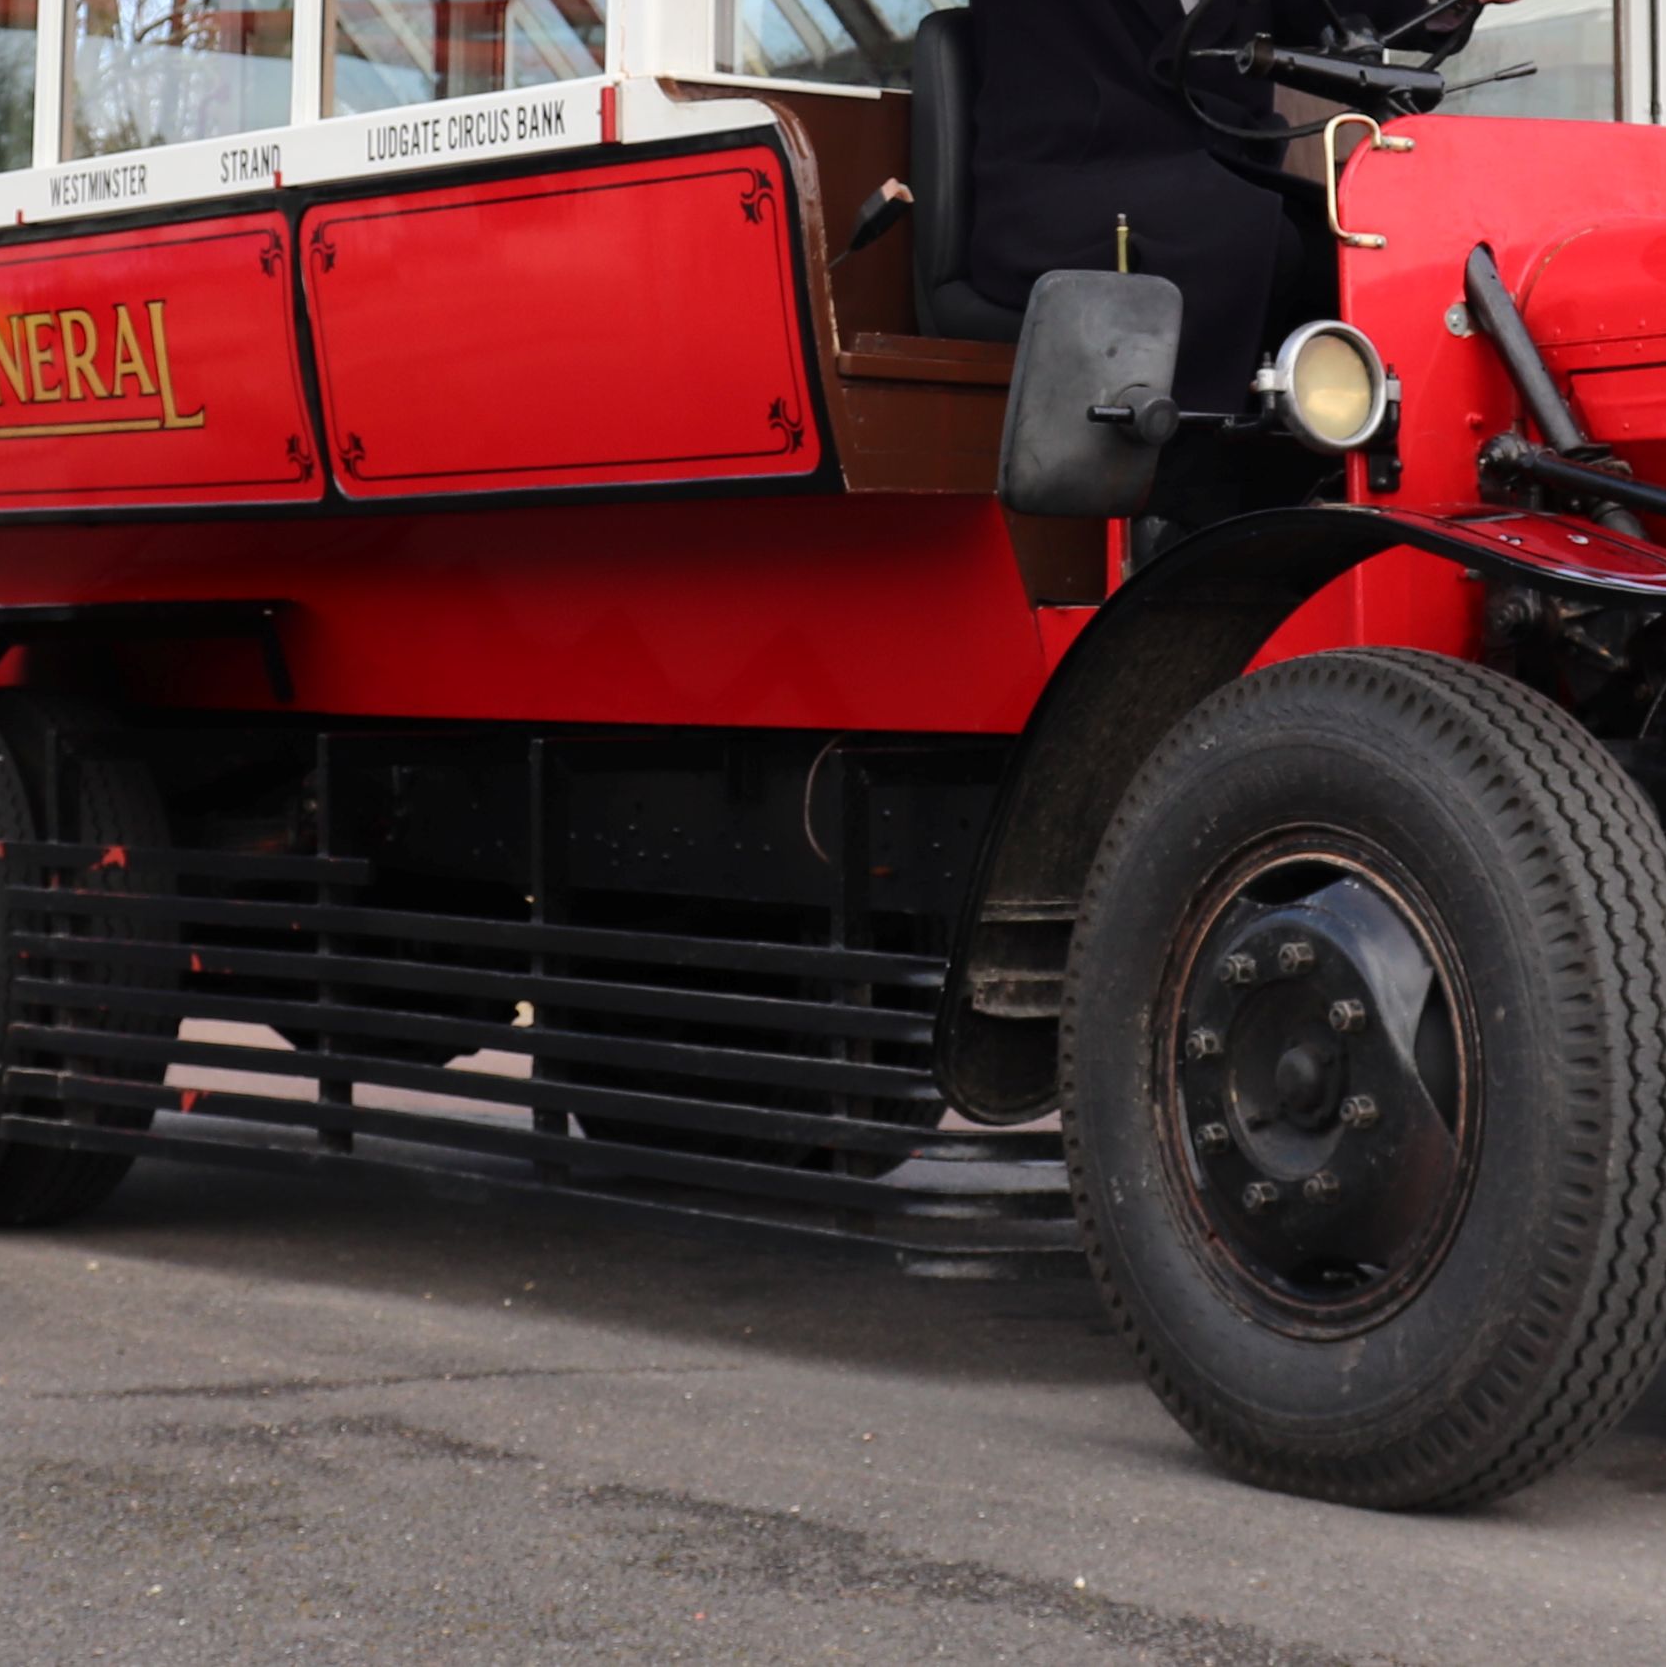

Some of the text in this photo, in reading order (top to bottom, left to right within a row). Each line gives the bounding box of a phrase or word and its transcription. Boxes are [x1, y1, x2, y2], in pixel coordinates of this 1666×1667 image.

[367, 100, 566, 162] LUDGATE CIRCUS BANK
[50, 164, 147, 207] WESTMINSTER
[220, 145, 281, 184] STRAND
